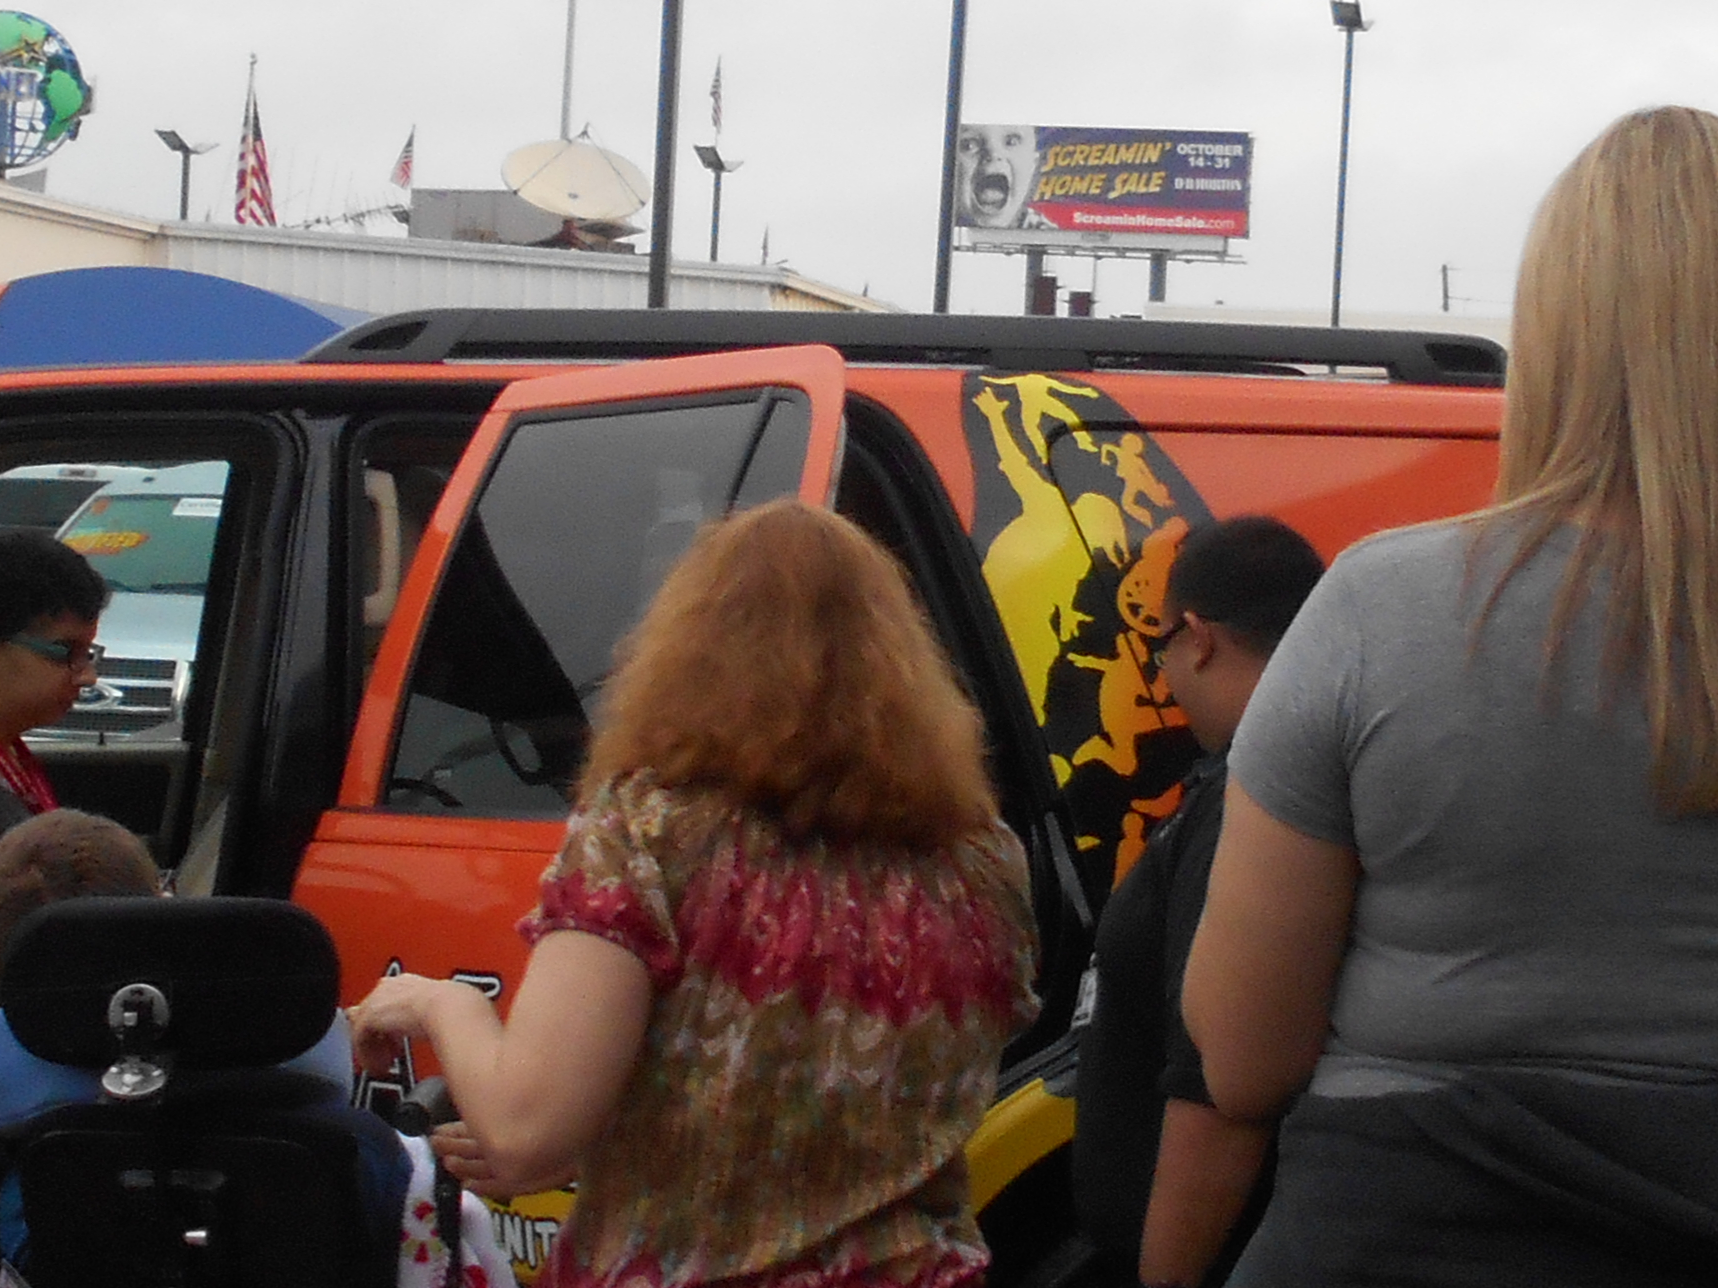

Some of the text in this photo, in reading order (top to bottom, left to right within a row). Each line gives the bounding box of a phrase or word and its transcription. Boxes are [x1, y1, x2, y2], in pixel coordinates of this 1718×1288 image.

[1041, 142, 1172, 172] SCREAMIN'
[1177, 143, 1243, 157] OCTOBER
[1034, 173, 1106, 201] HOME
[1108, 171, 1166, 199] SALE
